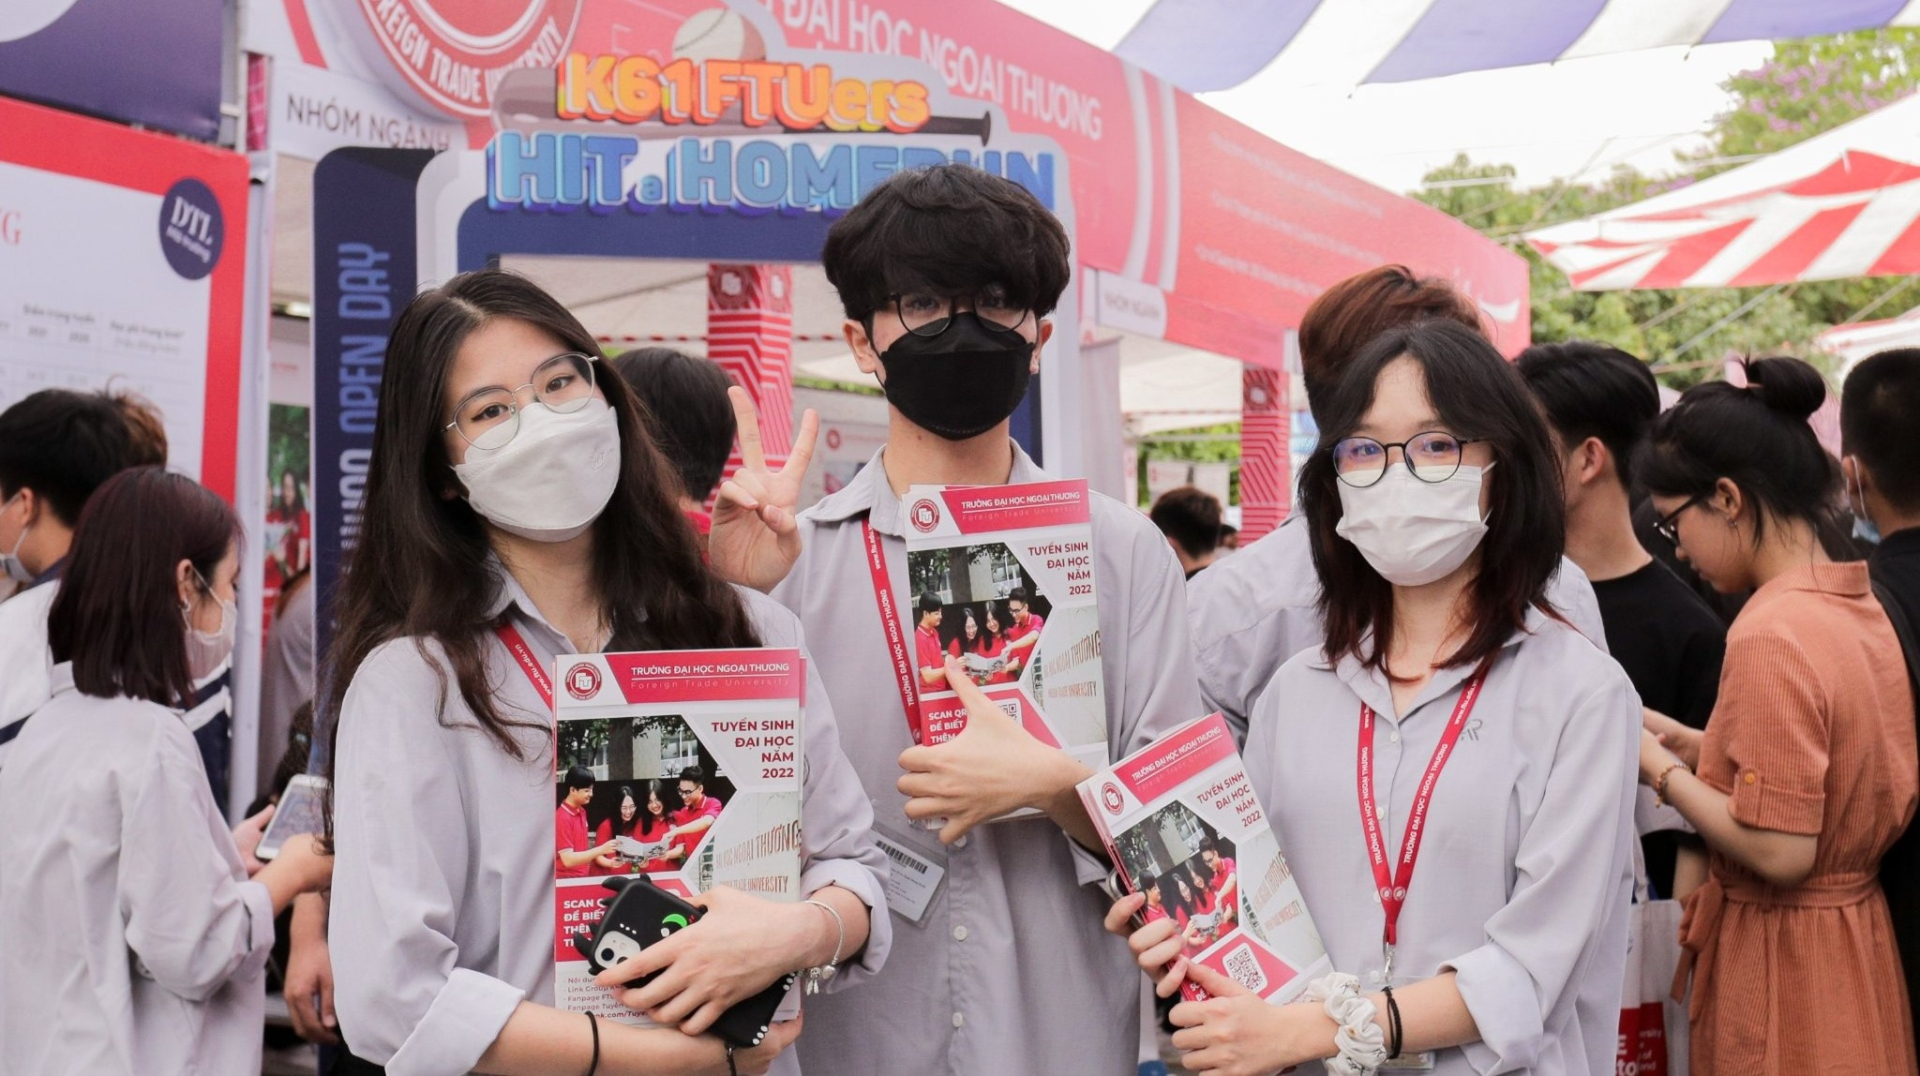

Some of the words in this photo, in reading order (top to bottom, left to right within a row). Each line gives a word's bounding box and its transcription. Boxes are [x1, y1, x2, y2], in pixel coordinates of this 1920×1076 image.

[374, 0, 431, 70] REIGN
[429, 47, 482, 104] TRADE
[286, 92, 360, 138] NHÓM
[487, 131, 641, 215] HIT
[630, 172, 666, 214] a
[338, 242, 391, 320] DAY
[338, 335, 390, 434] OPEN
[962, 512, 1000, 521] Foreign
[1004, 509, 1030, 517] Trade
[1034, 505, 1081, 514] University
[1064, 542, 1088, 552] SINH
[1047, 558, 1065, 570] ĐẠI
[1068, 556, 1089, 568] HỌC
[1067, 569, 1090, 580] NĂM
[1069, 584, 1092, 595] 2022
[674, 664, 690, 677] ĐẠI
[693, 664, 715, 676] HỌC
[716, 663, 747, 675] NGOẠI
[630, 681, 678, 690] Foreign
[684, 679, 719, 687] Trade
[726, 677, 790, 687] University
[928, 710, 953, 720] SCAN
[954, 708, 968, 718] QR
[761, 720, 794, 731] SINH
[944, 718, 964, 730] BIẾT
[735, 737, 760, 750] ĐẠI
[764, 736, 794, 748] HỌC
[762, 750, 794, 762] NĂM
[762, 767, 794, 778] 2022
[1224, 771, 1245, 788] SINH
[1215, 795, 1231, 810] ĐẠI
[1235, 797, 1256, 814] NĂM
[1241, 810, 1262, 827] 2022
[747, 876, 789, 893] UNIVERSITY
[563, 899, 594, 909] SCAN
[567, 994, 600, 1003] Fanpage
